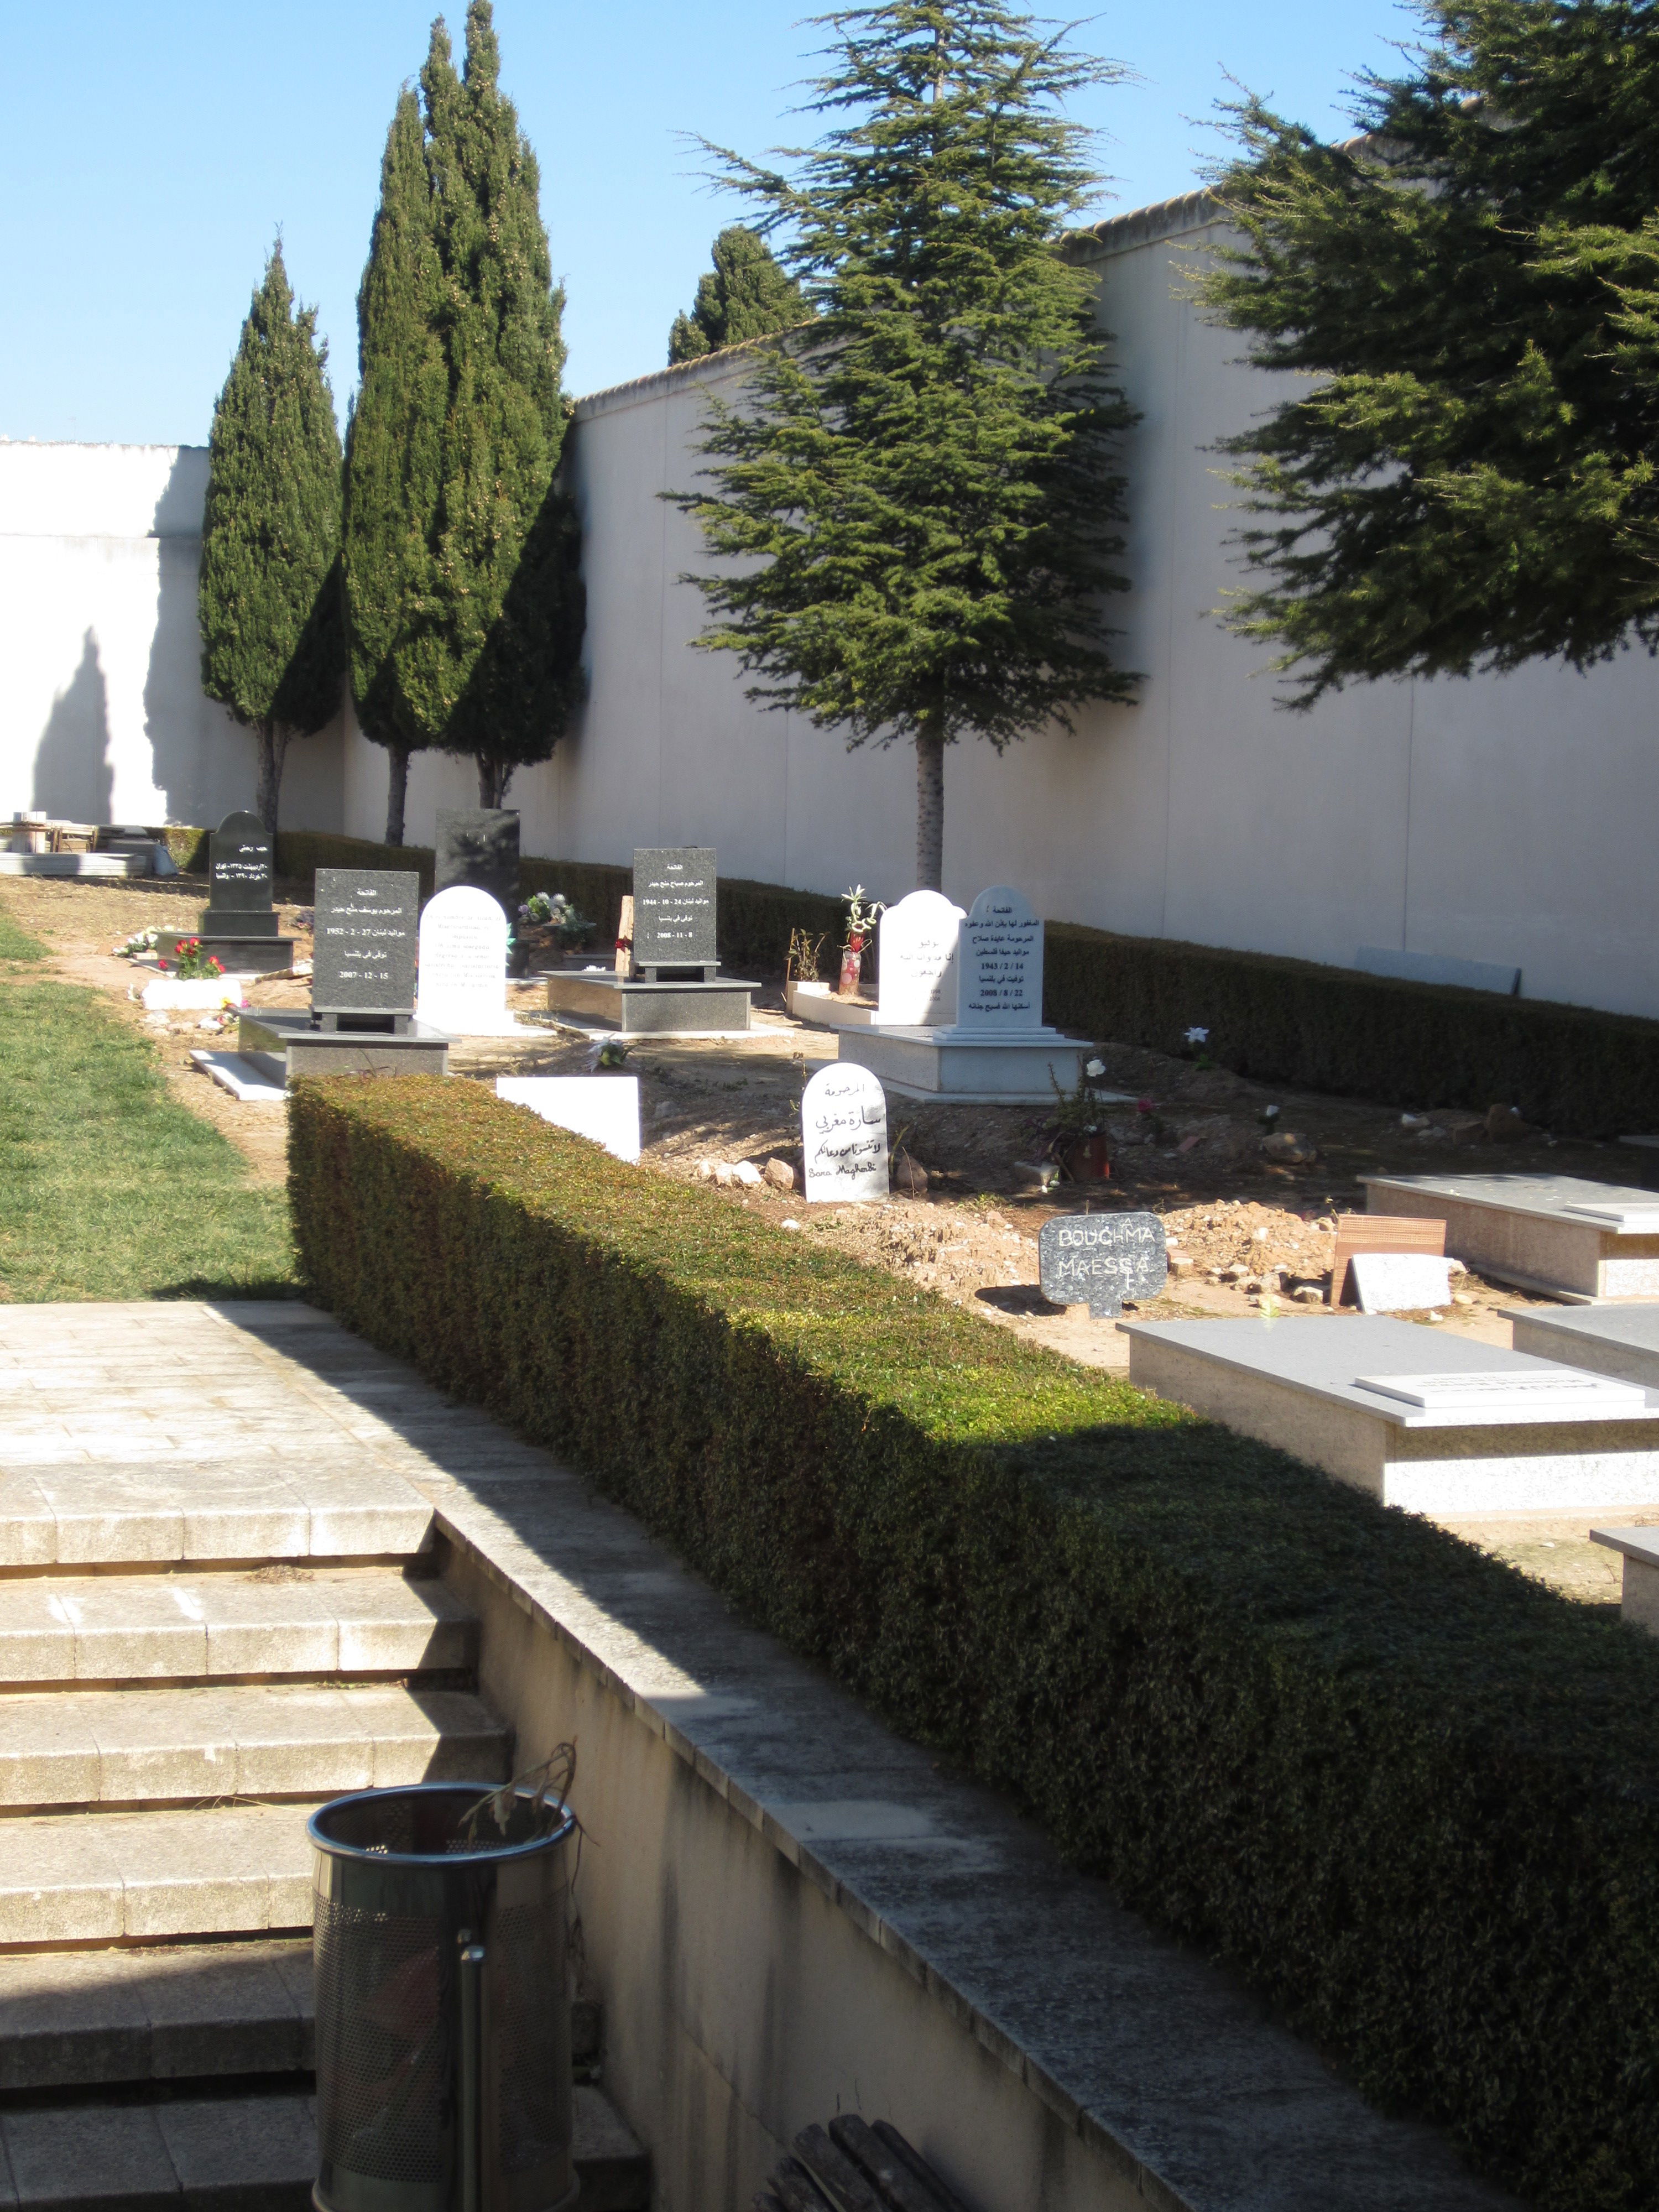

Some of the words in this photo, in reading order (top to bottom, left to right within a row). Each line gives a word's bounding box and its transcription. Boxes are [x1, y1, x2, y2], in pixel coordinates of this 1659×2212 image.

[1008, 934, 1034, 943] المرحومة
[976, 947, 997, 956] فلسطين
[849, 1105, 881, 1130] سارة
[808, 1168, 832, 1178] Sara
